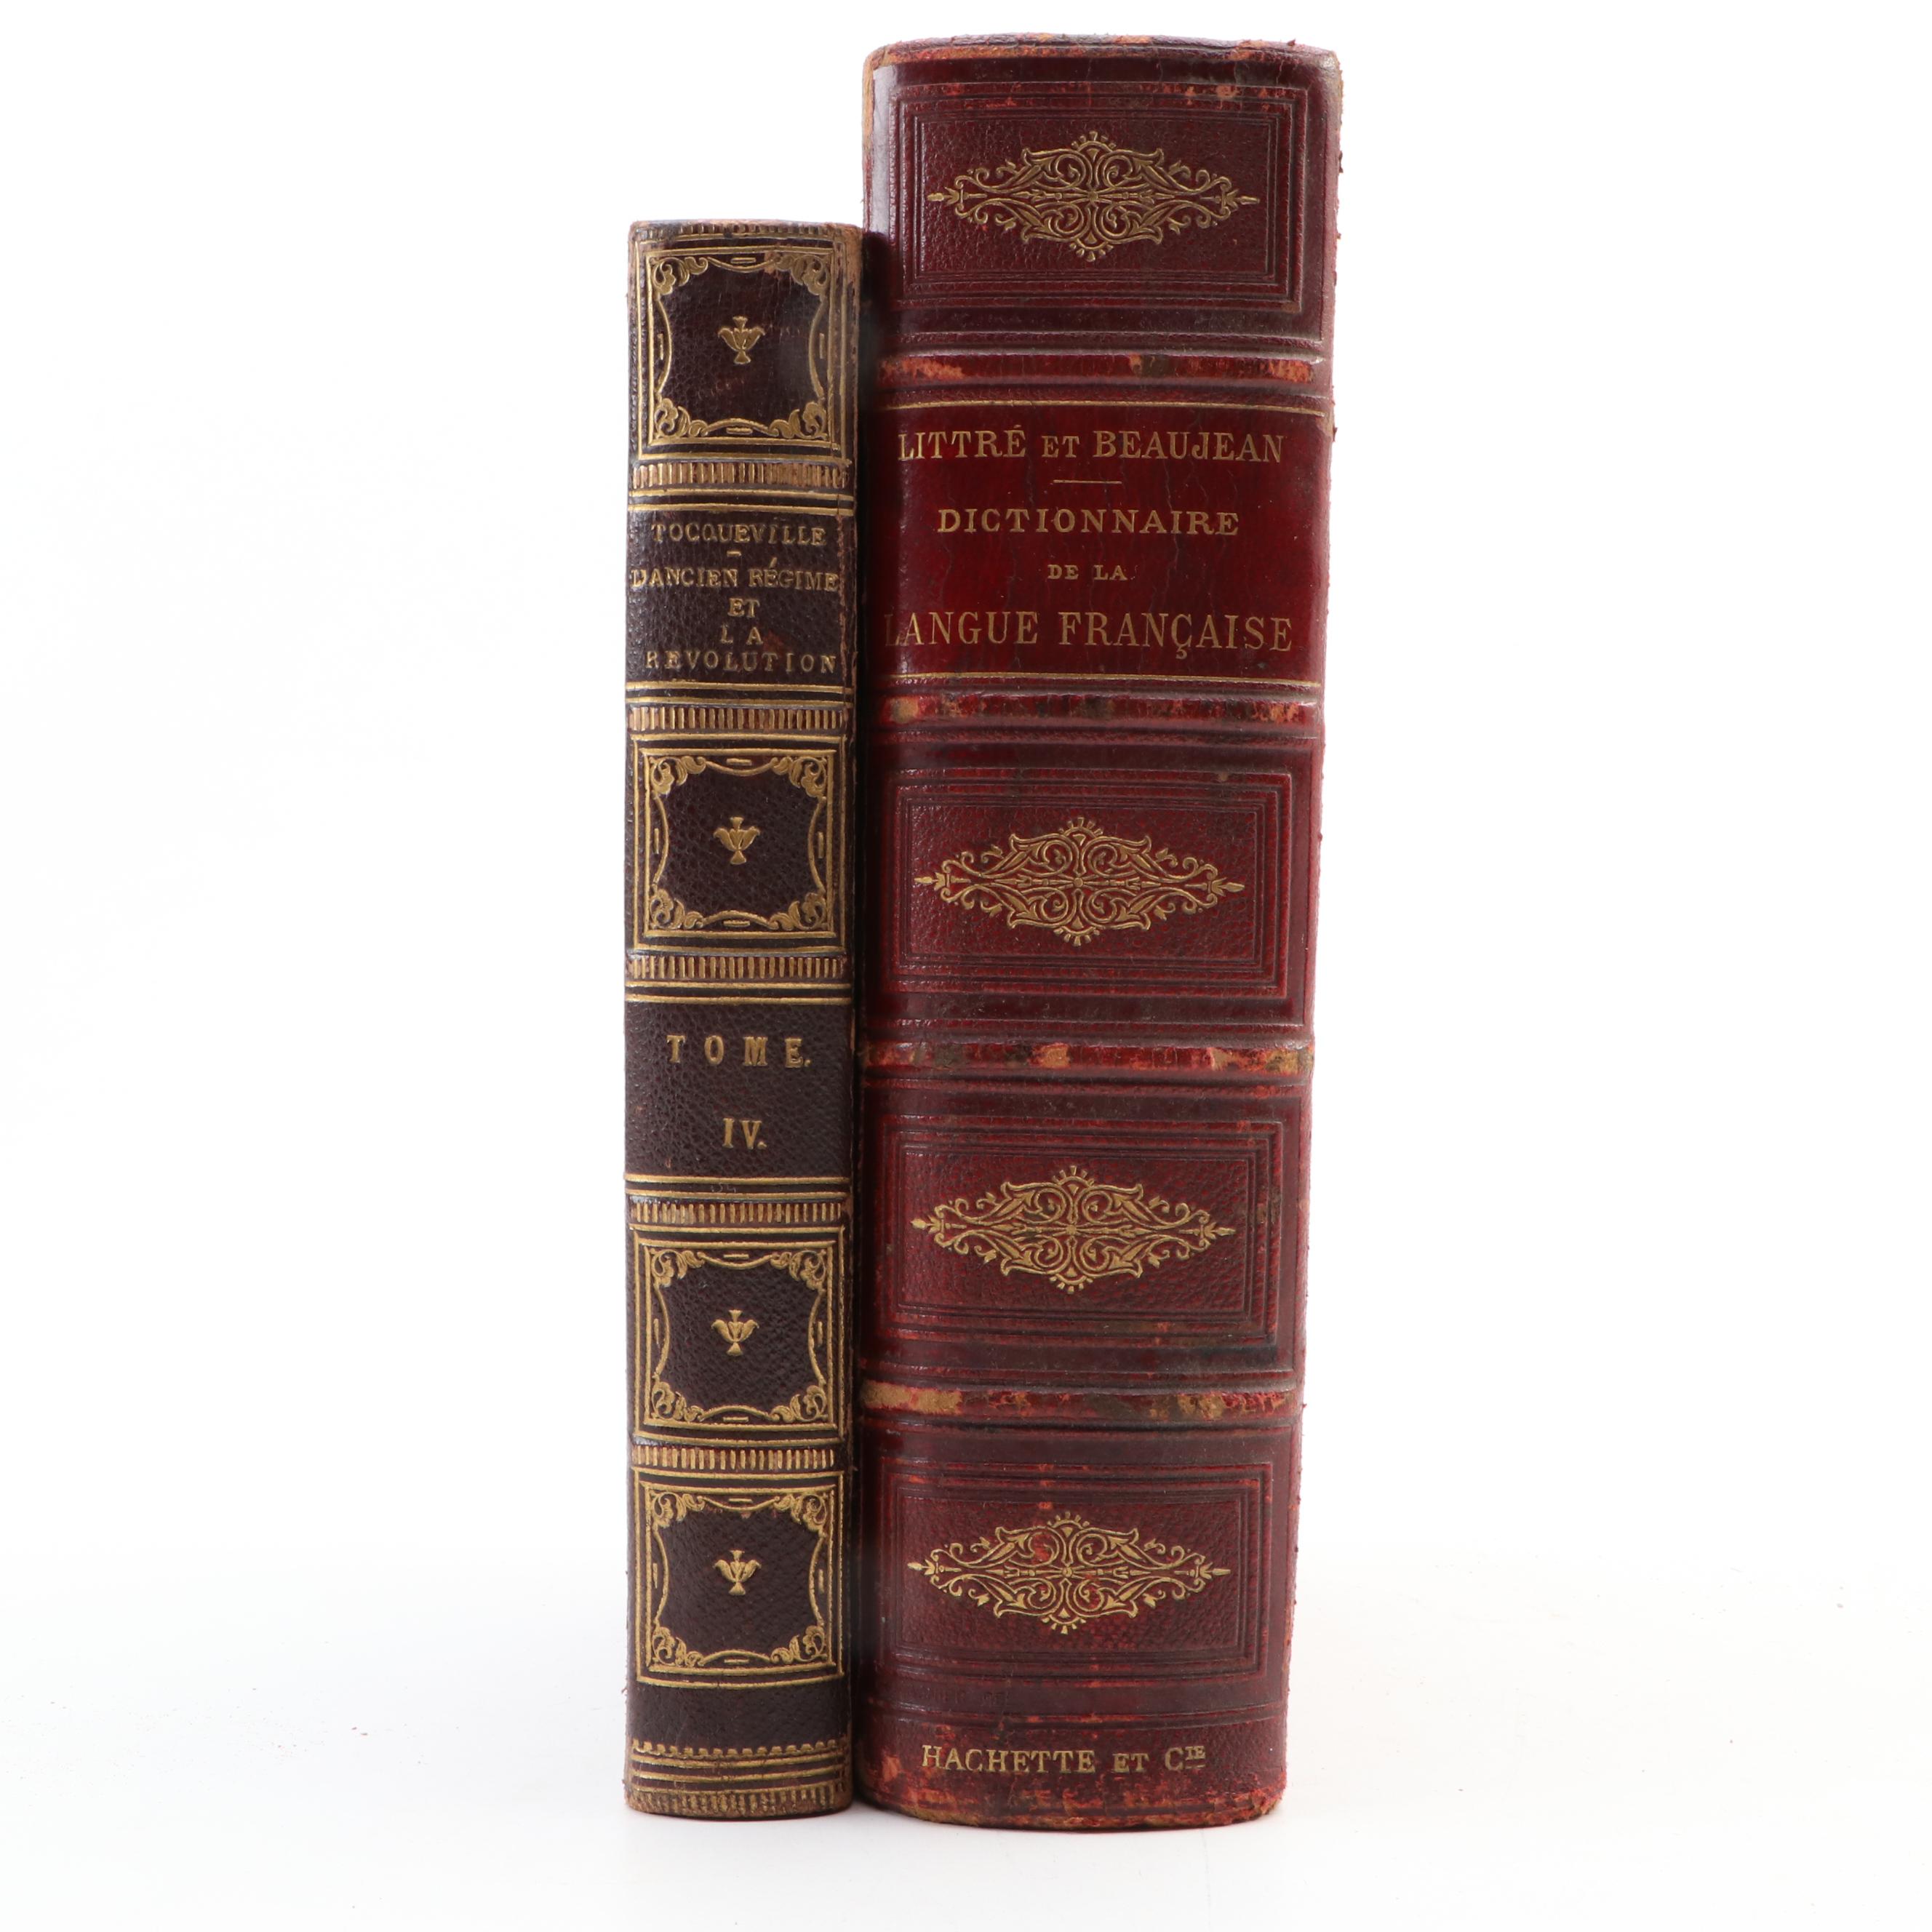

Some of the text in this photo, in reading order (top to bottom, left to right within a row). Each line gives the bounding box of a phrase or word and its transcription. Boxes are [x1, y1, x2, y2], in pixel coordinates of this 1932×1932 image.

[898, 425, 1283, 463] LITTRÉ ET BEAUJEAN
[651, 522, 826, 546] TOCQUEVILLE
[937, 508, 1239, 535] DICTIONNAIRE
[749, 556, 839, 592] RÉGIME
[1047, 564, 1078, 580] DE
[728, 598, 760, 618] ET
[884, 611, 1293, 659] LANGUE FRANÇAISE
[645, 650, 836, 674] REVOLUTION
[722, 1118, 767, 1149] IV.
[922, 1744, 1096, 1773] HACHETTE
[1112, 1752, 1150, 1773] ET
